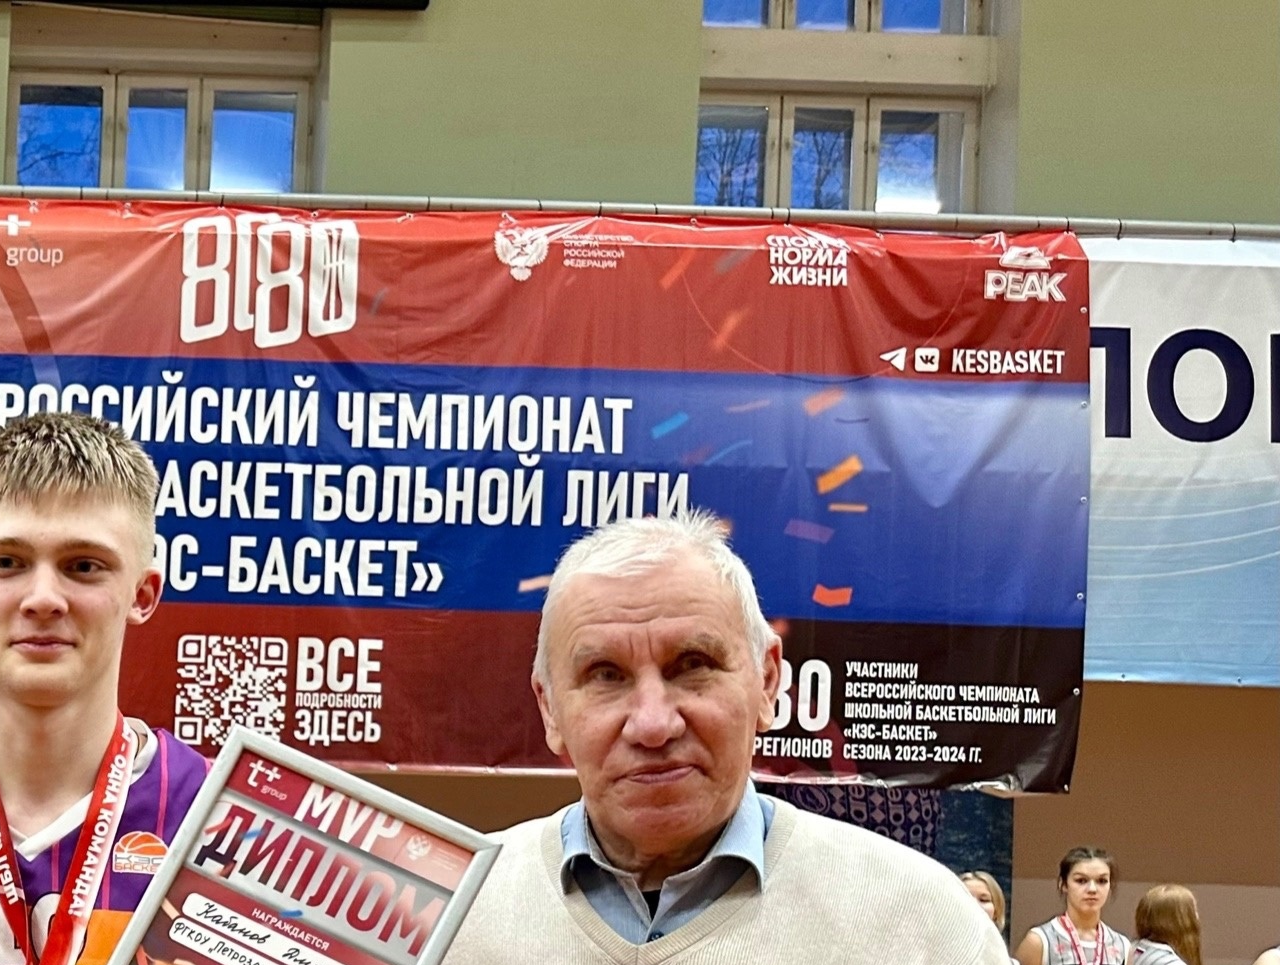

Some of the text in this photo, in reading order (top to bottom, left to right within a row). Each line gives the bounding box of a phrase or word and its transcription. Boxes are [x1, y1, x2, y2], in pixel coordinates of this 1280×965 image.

[6, 245, 63, 267] group
[563, 248, 625, 259] РОССИЙСКОЙ
[563, 259, 617, 269] ФЕДЕРАЦИИ
[770, 249, 848, 266] НОРМА
[769, 266, 848, 286] ЖИЗНИ
[984, 270, 1066, 302] PEAK
[951, 349, 1065, 374] KESBASKET
[337, 390, 633, 455] ЧЕМПИОНАТ
[562, 470, 690, 528] ЛИГИ
[295, 637, 383, 693] ВСЕ
[846, 661, 919, 679] УЧАСТНИКИ
[295, 692, 382, 709] ПОДРОБНОСТИ
[845, 681, 1040, 704] ВСЕРОССИЙСКОГО ЧЕМПИОНАТА
[844, 701, 1057, 725] ШКОЛЬНОЙ БАСКЕТБОЛЬНОЙ ЛИГИ
[293, 709, 382, 747] ЗДЕСЬ
[843, 724, 938, 742] «КЭС-БАСКЕТ»
[753, 737, 833, 759] РЕГИОНОВ
[843, 746, 892, 760] СЕЗОНА
[894, 746, 966, 762] 2023-2024
[102, 755, 126, 806] ОДНА
[260, 785, 288, 802] group
[294, 781, 404, 853] MVP
[68, 809, 114, 918] КОМАНДА!
[193, 803, 446, 957] ДИПЛОМ
[196, 902, 272, 946] Кабанов
[251, 907, 329, 952] НАГРАЖДАЕТСЯ
